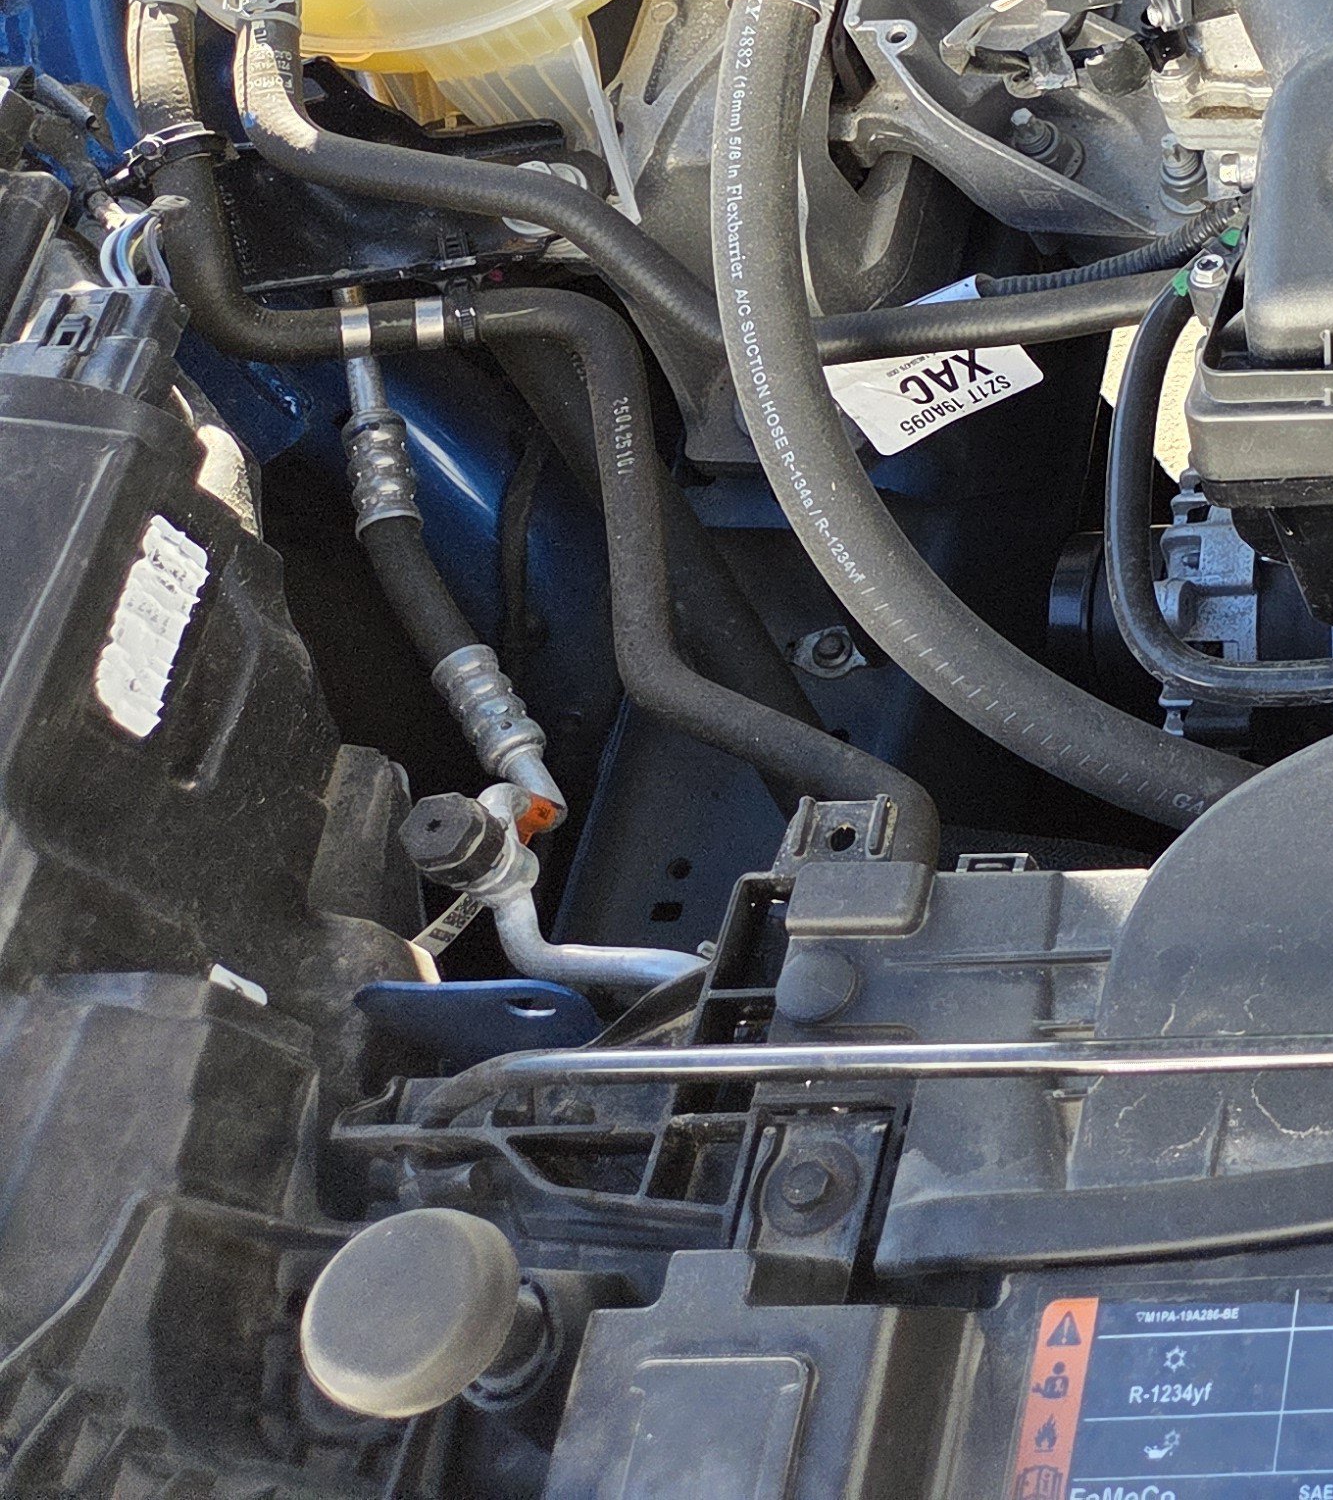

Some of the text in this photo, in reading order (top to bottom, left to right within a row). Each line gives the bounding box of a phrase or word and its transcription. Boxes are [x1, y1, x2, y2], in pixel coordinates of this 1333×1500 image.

[737, 23, 757, 69] 4882
[727, 73, 746, 130] (16mm)
[727, 135, 742, 160] 5/8
[725, 182, 745, 281] Flexbarrier
[734, 288, 752, 317] A/C
[740, 320, 773, 401] SUCTION
[898, 348, 995, 403] XAC
[760, 398, 790, 451] HOSE
[899, 373, 1013, 436] SZ1T 19A095
[781, 449, 814, 509] R-134a
[1129, 1380, 1213, 1406] R-1234yf
